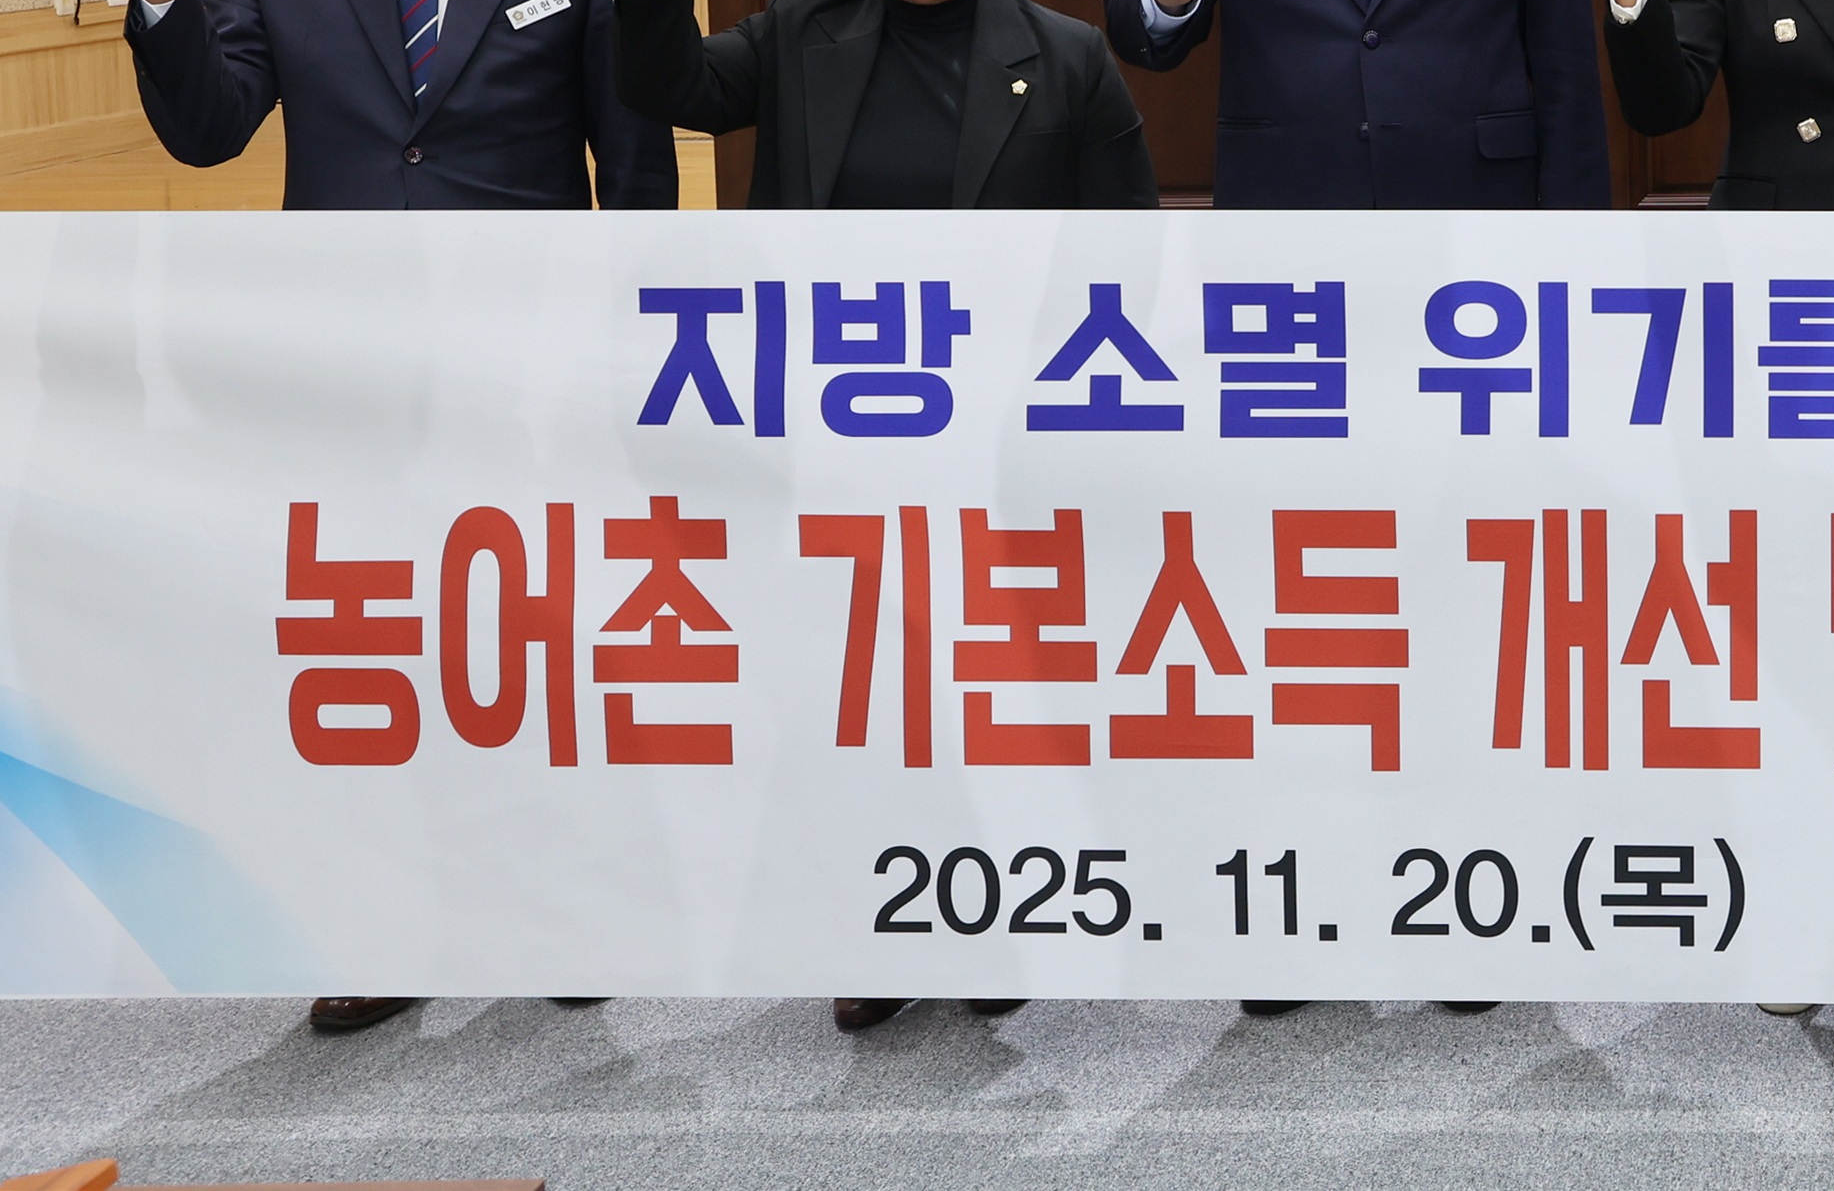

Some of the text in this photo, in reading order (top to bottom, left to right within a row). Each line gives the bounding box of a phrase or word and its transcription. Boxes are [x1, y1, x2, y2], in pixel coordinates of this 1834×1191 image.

[635, 279, 972, 439] 지방
[1025, 280, 1350, 440] 소멸
[274, 494, 740, 768] 농어촌
[797, 504, 1410, 773] 기본소득
[1465, 507, 1762, 772] 개선
[872, 835, 1746, 953] 2025. 11. 20.(목)
